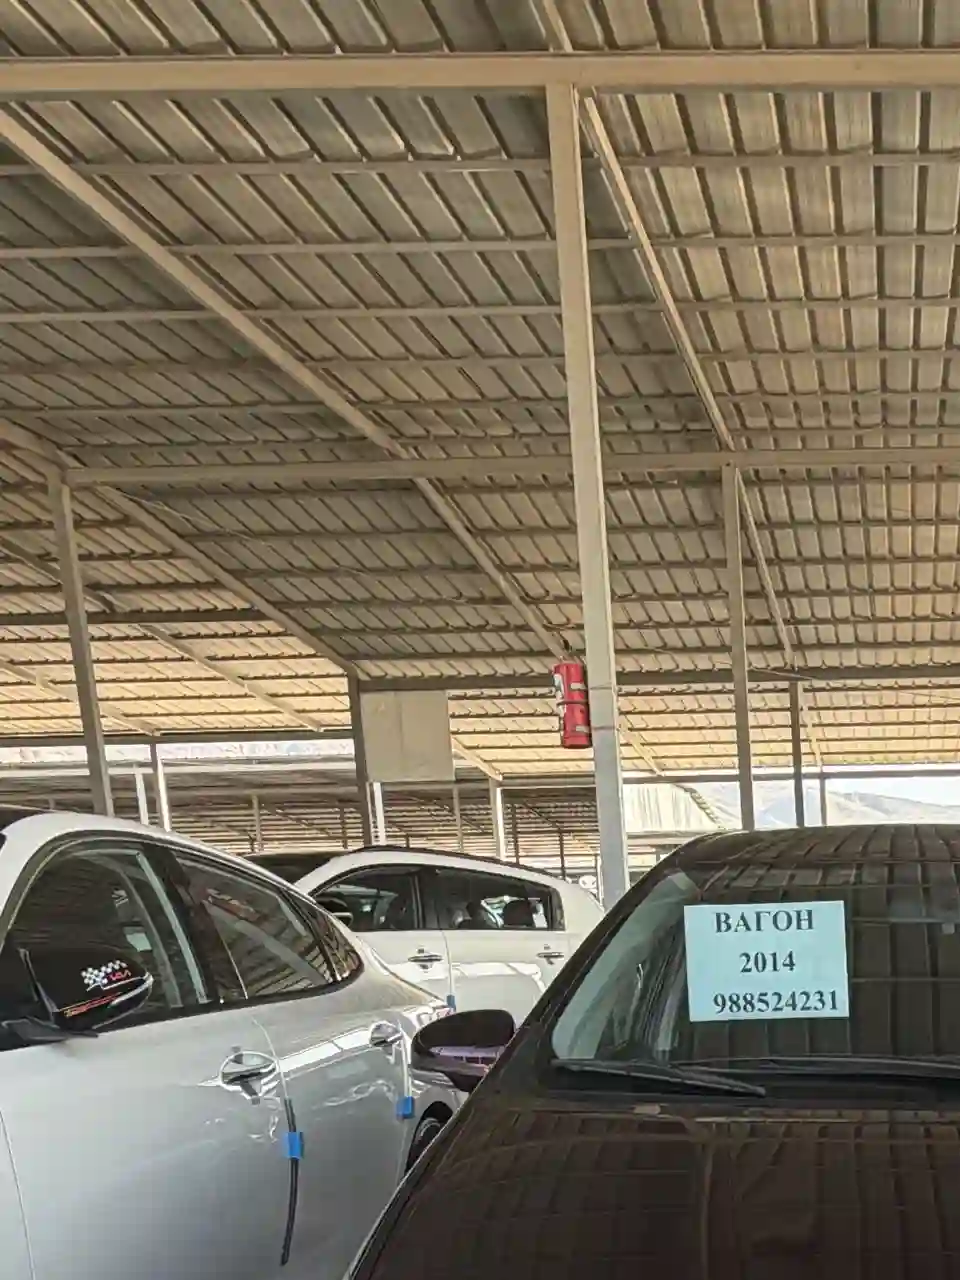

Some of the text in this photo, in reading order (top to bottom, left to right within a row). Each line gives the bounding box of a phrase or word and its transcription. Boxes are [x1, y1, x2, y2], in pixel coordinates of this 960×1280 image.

[714, 909, 814, 933] ВАГОН
[739, 950, 796, 973] 2014
[713, 990, 838, 1014] 988524231
